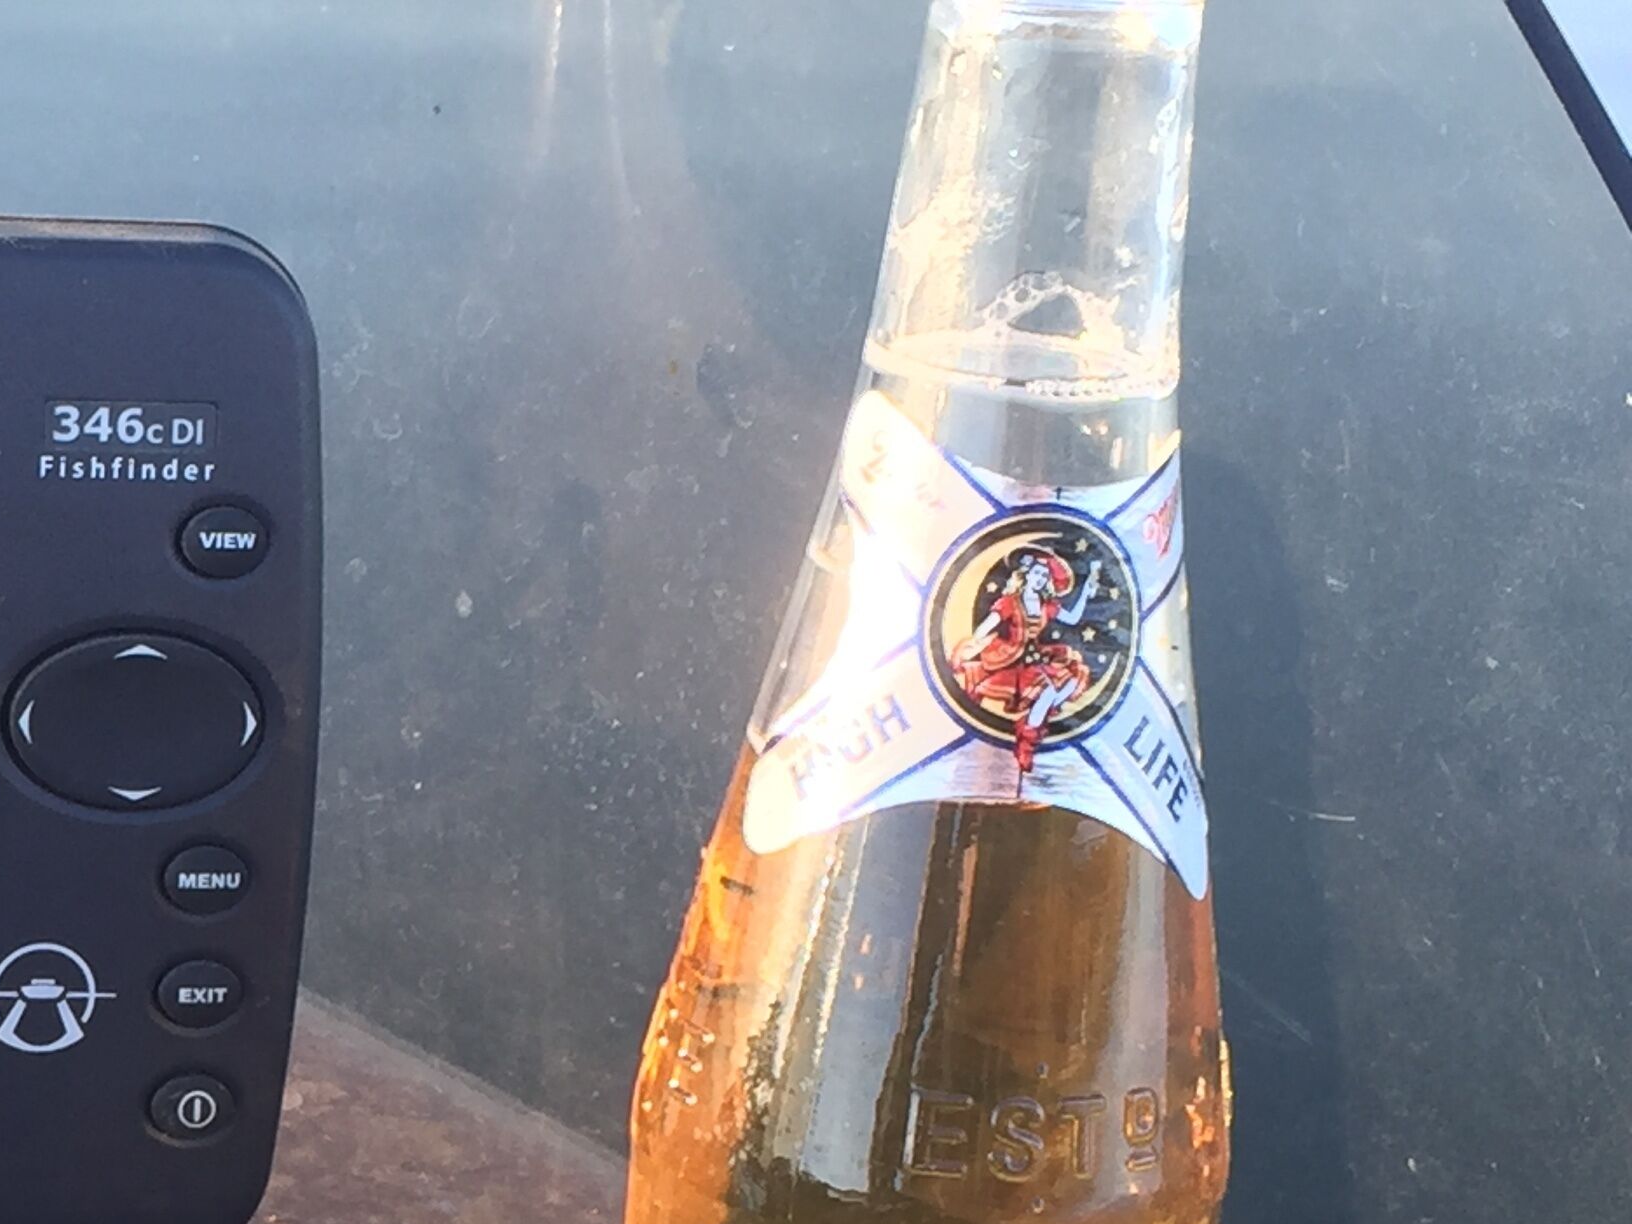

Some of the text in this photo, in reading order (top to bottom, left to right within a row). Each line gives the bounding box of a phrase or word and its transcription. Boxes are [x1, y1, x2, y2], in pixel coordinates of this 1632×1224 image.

[38, 455, 215, 482] Fishfinder
[199, 532, 257, 549] VIEW
[1123, 714, 1188, 823] LIFE
[178, 872, 241, 890] MENU
[178, 986, 228, 1005] EXIT
